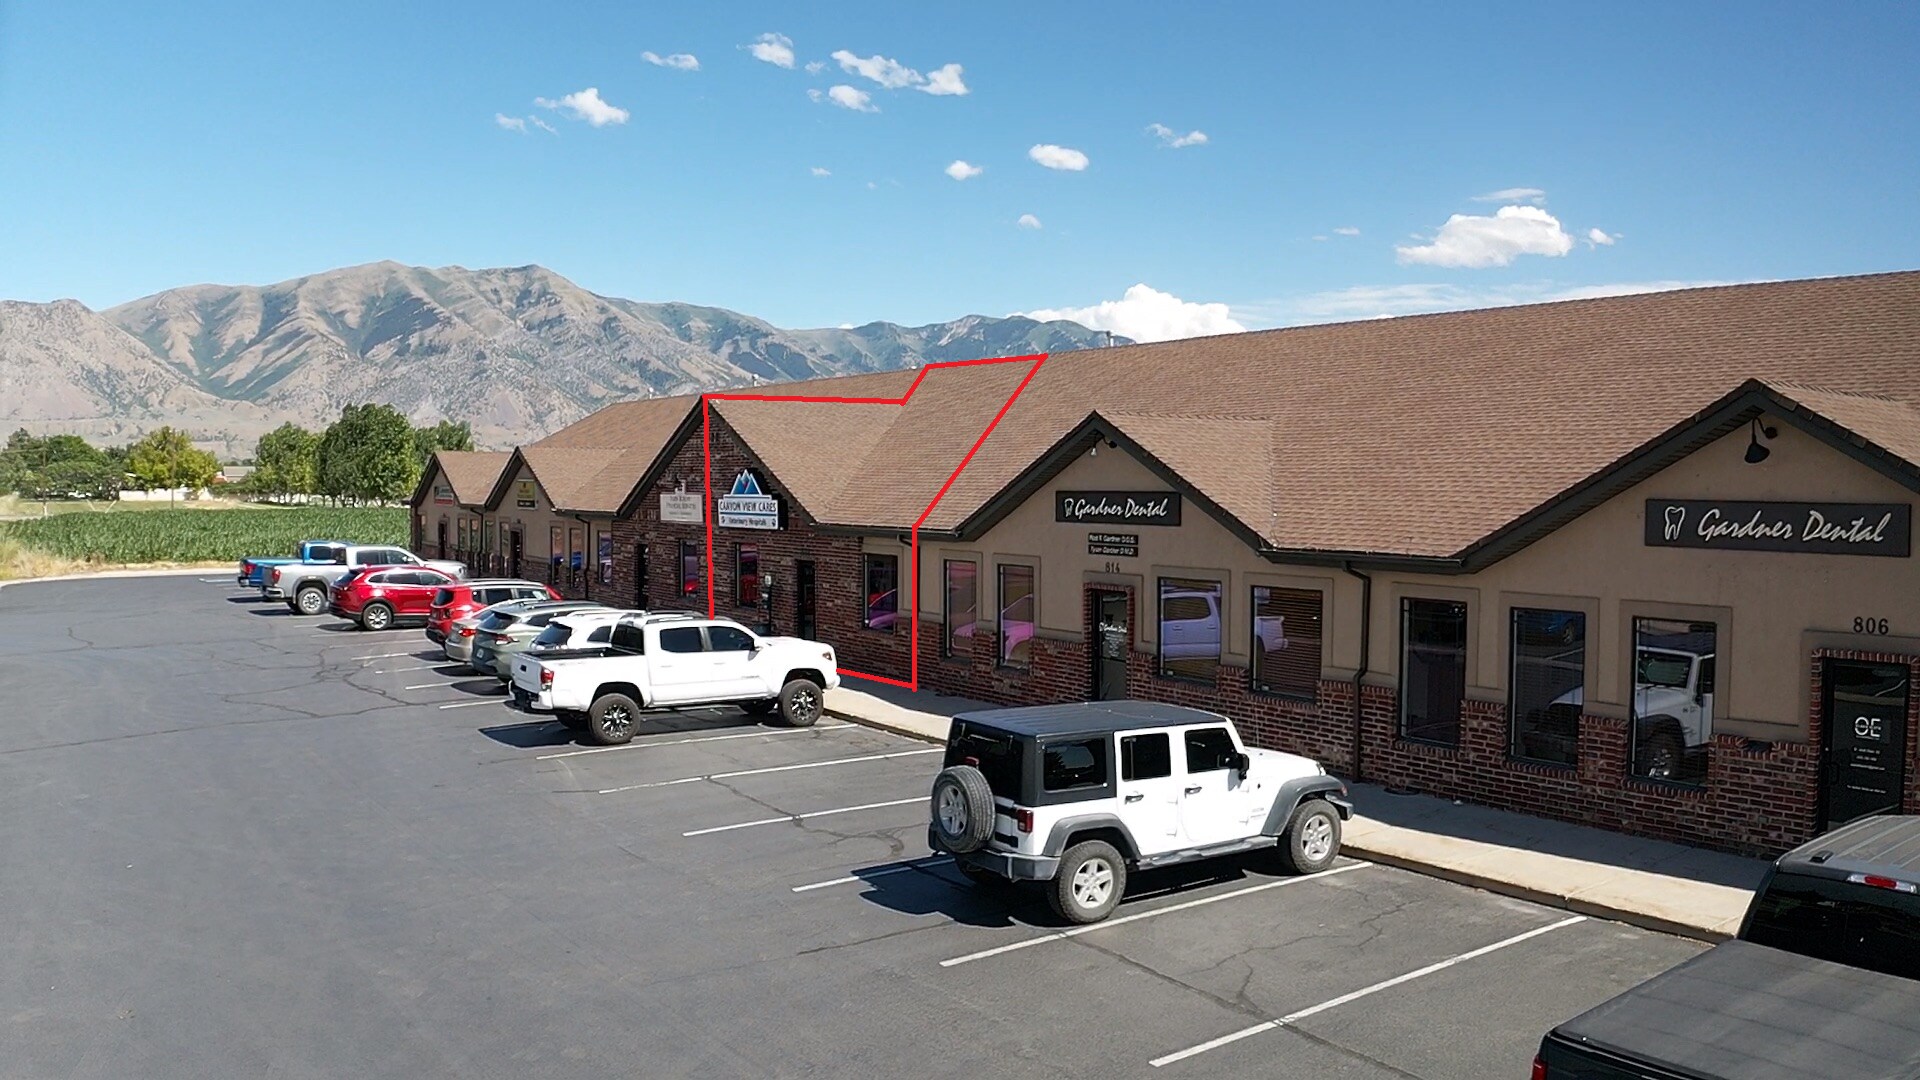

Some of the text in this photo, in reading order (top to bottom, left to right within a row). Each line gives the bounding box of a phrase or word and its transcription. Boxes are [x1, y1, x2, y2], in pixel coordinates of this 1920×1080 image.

[719, 501, 776, 513] CANYON VIEW CARES
[1075, 496, 1169, 519] Gardner Dental
[1697, 508, 1892, 543] Gardner Dental
[1105, 562, 1120, 573] 814
[1853, 616, 1889, 635] 806
